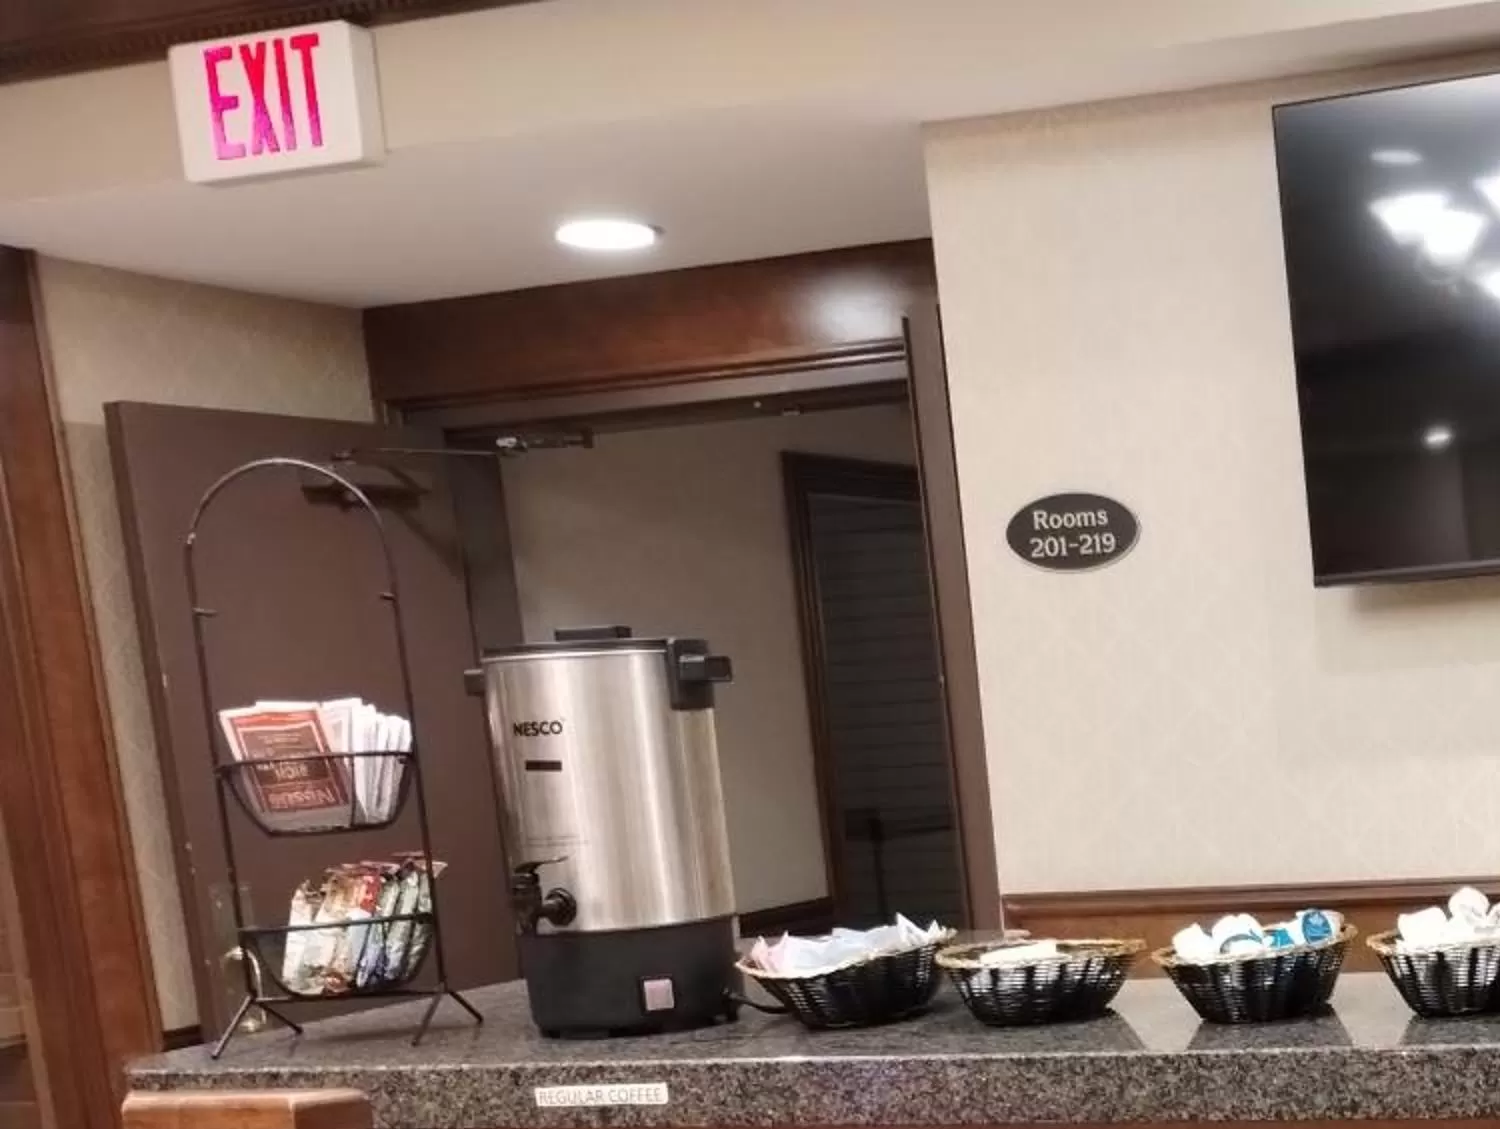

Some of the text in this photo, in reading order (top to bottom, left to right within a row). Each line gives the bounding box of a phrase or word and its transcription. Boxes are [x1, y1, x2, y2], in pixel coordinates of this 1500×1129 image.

[203, 32, 324, 161] EXIT
[1032, 509, 1109, 530] Rooms
[1030, 532, 1116, 558] 201-219
[513, 720, 563, 737] NESCO
[539, 1087, 661, 1105] REGULAR COFFEE
